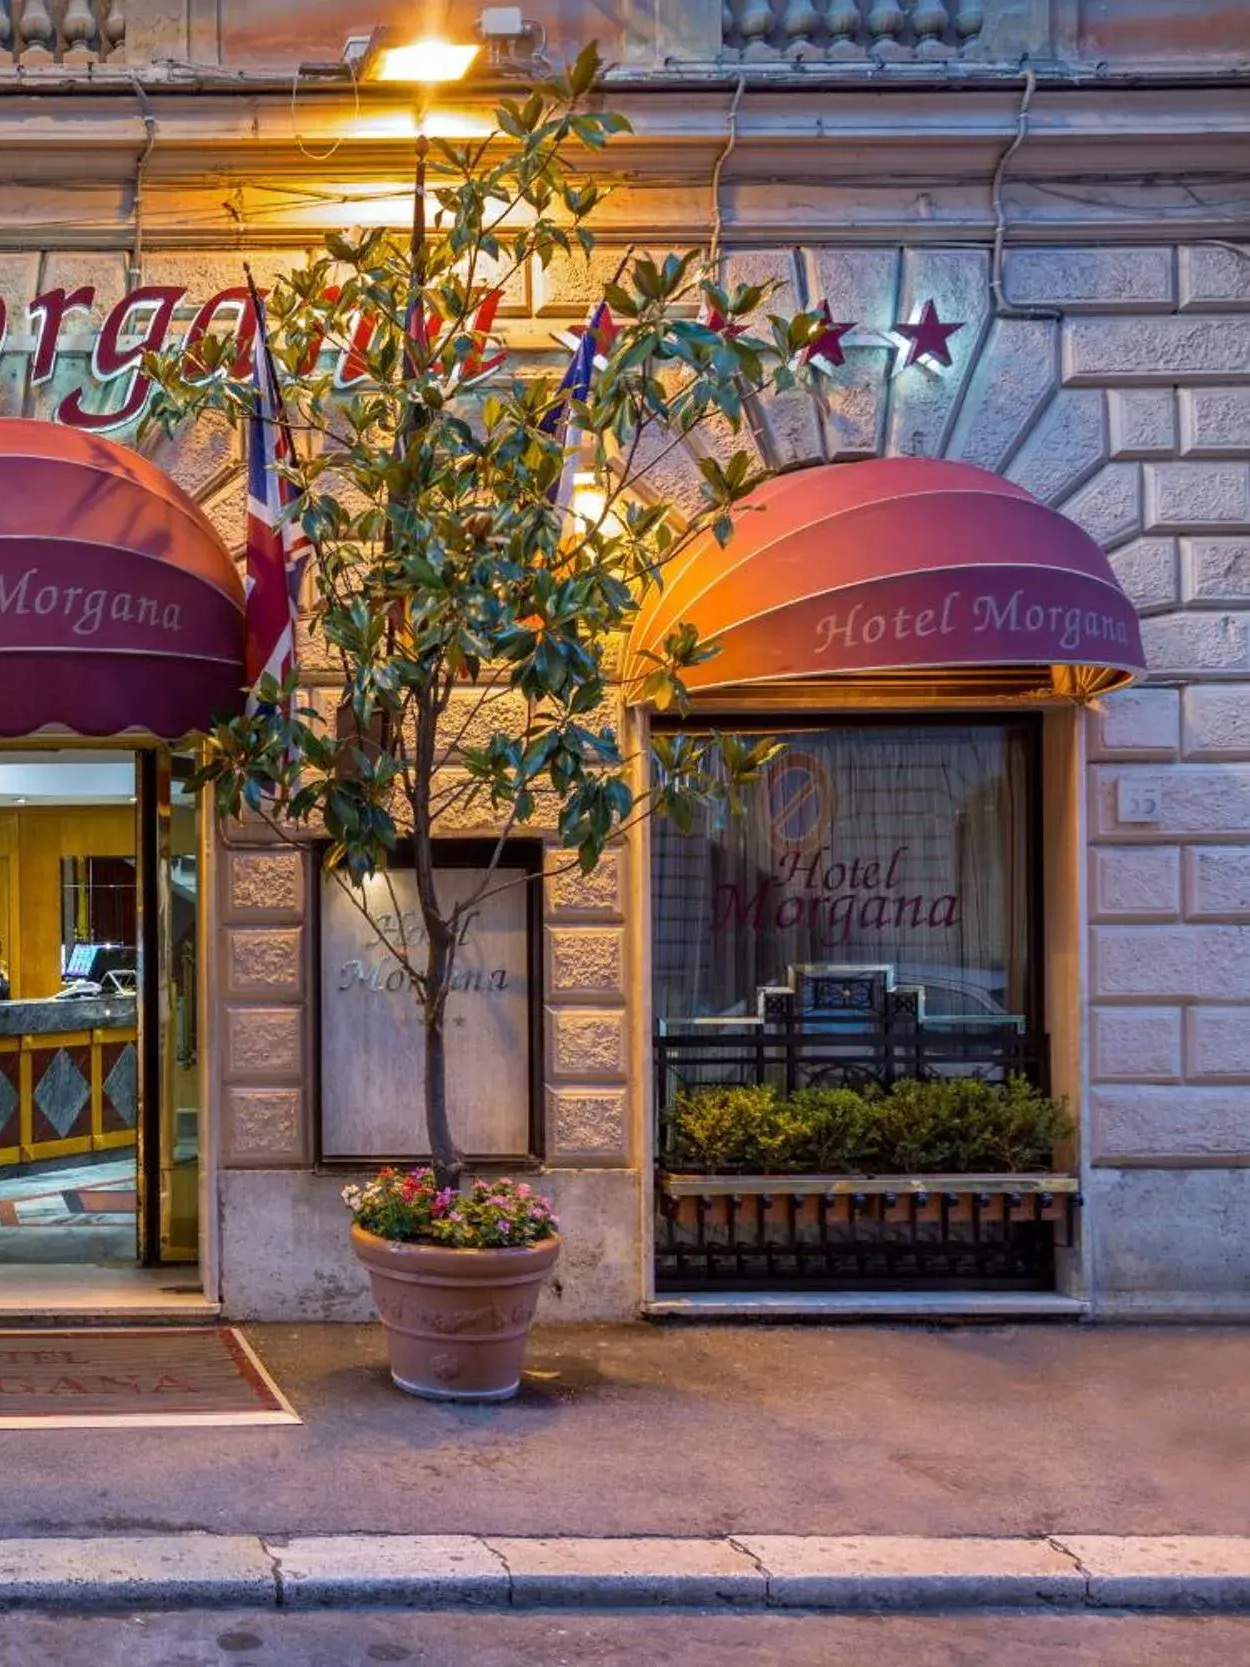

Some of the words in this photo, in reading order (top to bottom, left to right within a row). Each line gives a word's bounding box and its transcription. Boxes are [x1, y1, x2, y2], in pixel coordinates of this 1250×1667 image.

[814, 591, 961, 654] Hotel
[972, 590, 1129, 650] Morgana
[771, 846, 909, 891] Hotel
[708, 878, 964, 948] Morgana
